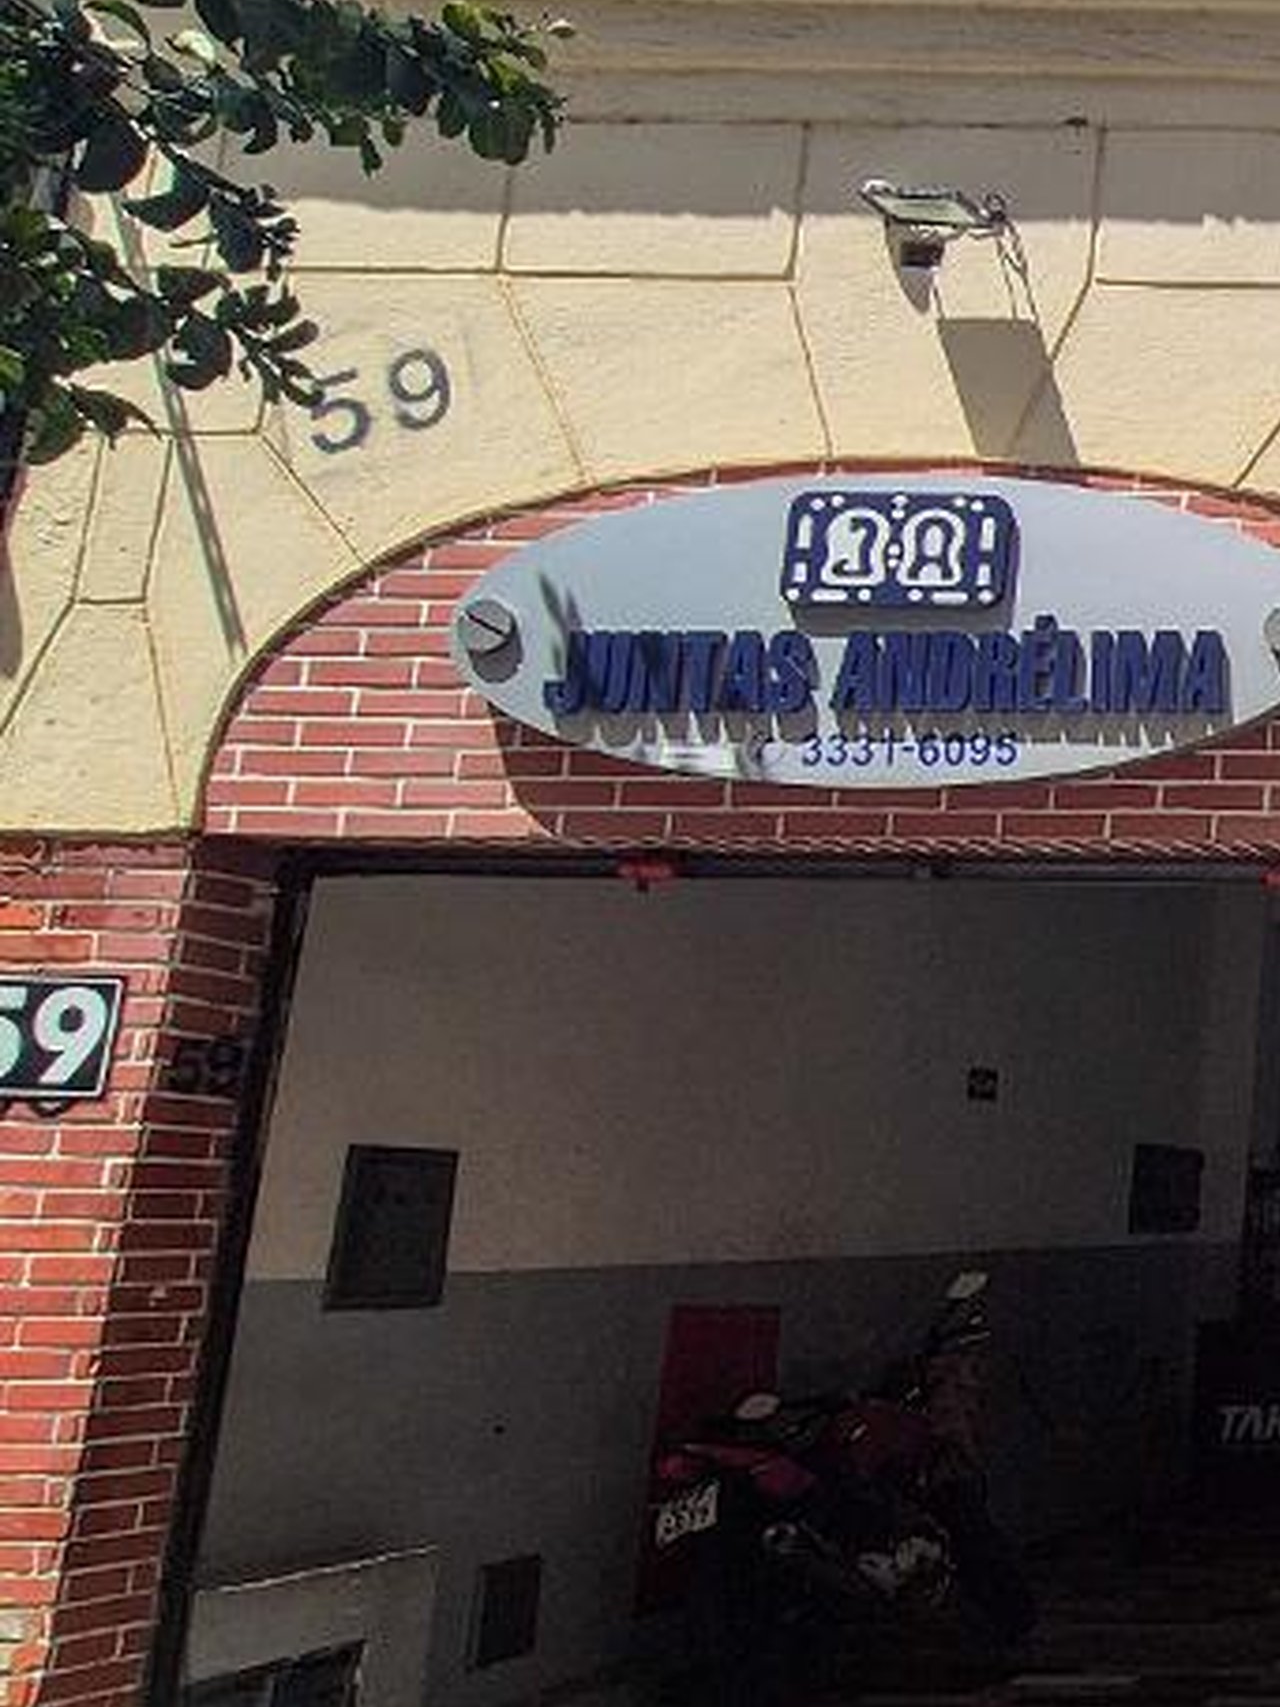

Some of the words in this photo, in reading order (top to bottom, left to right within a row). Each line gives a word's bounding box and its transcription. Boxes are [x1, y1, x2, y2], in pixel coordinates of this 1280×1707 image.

[310, 349, 451, 454] 59
[544, 630, 812, 714] JUNTAS
[802, 733, 1017, 767] 3331-6095
